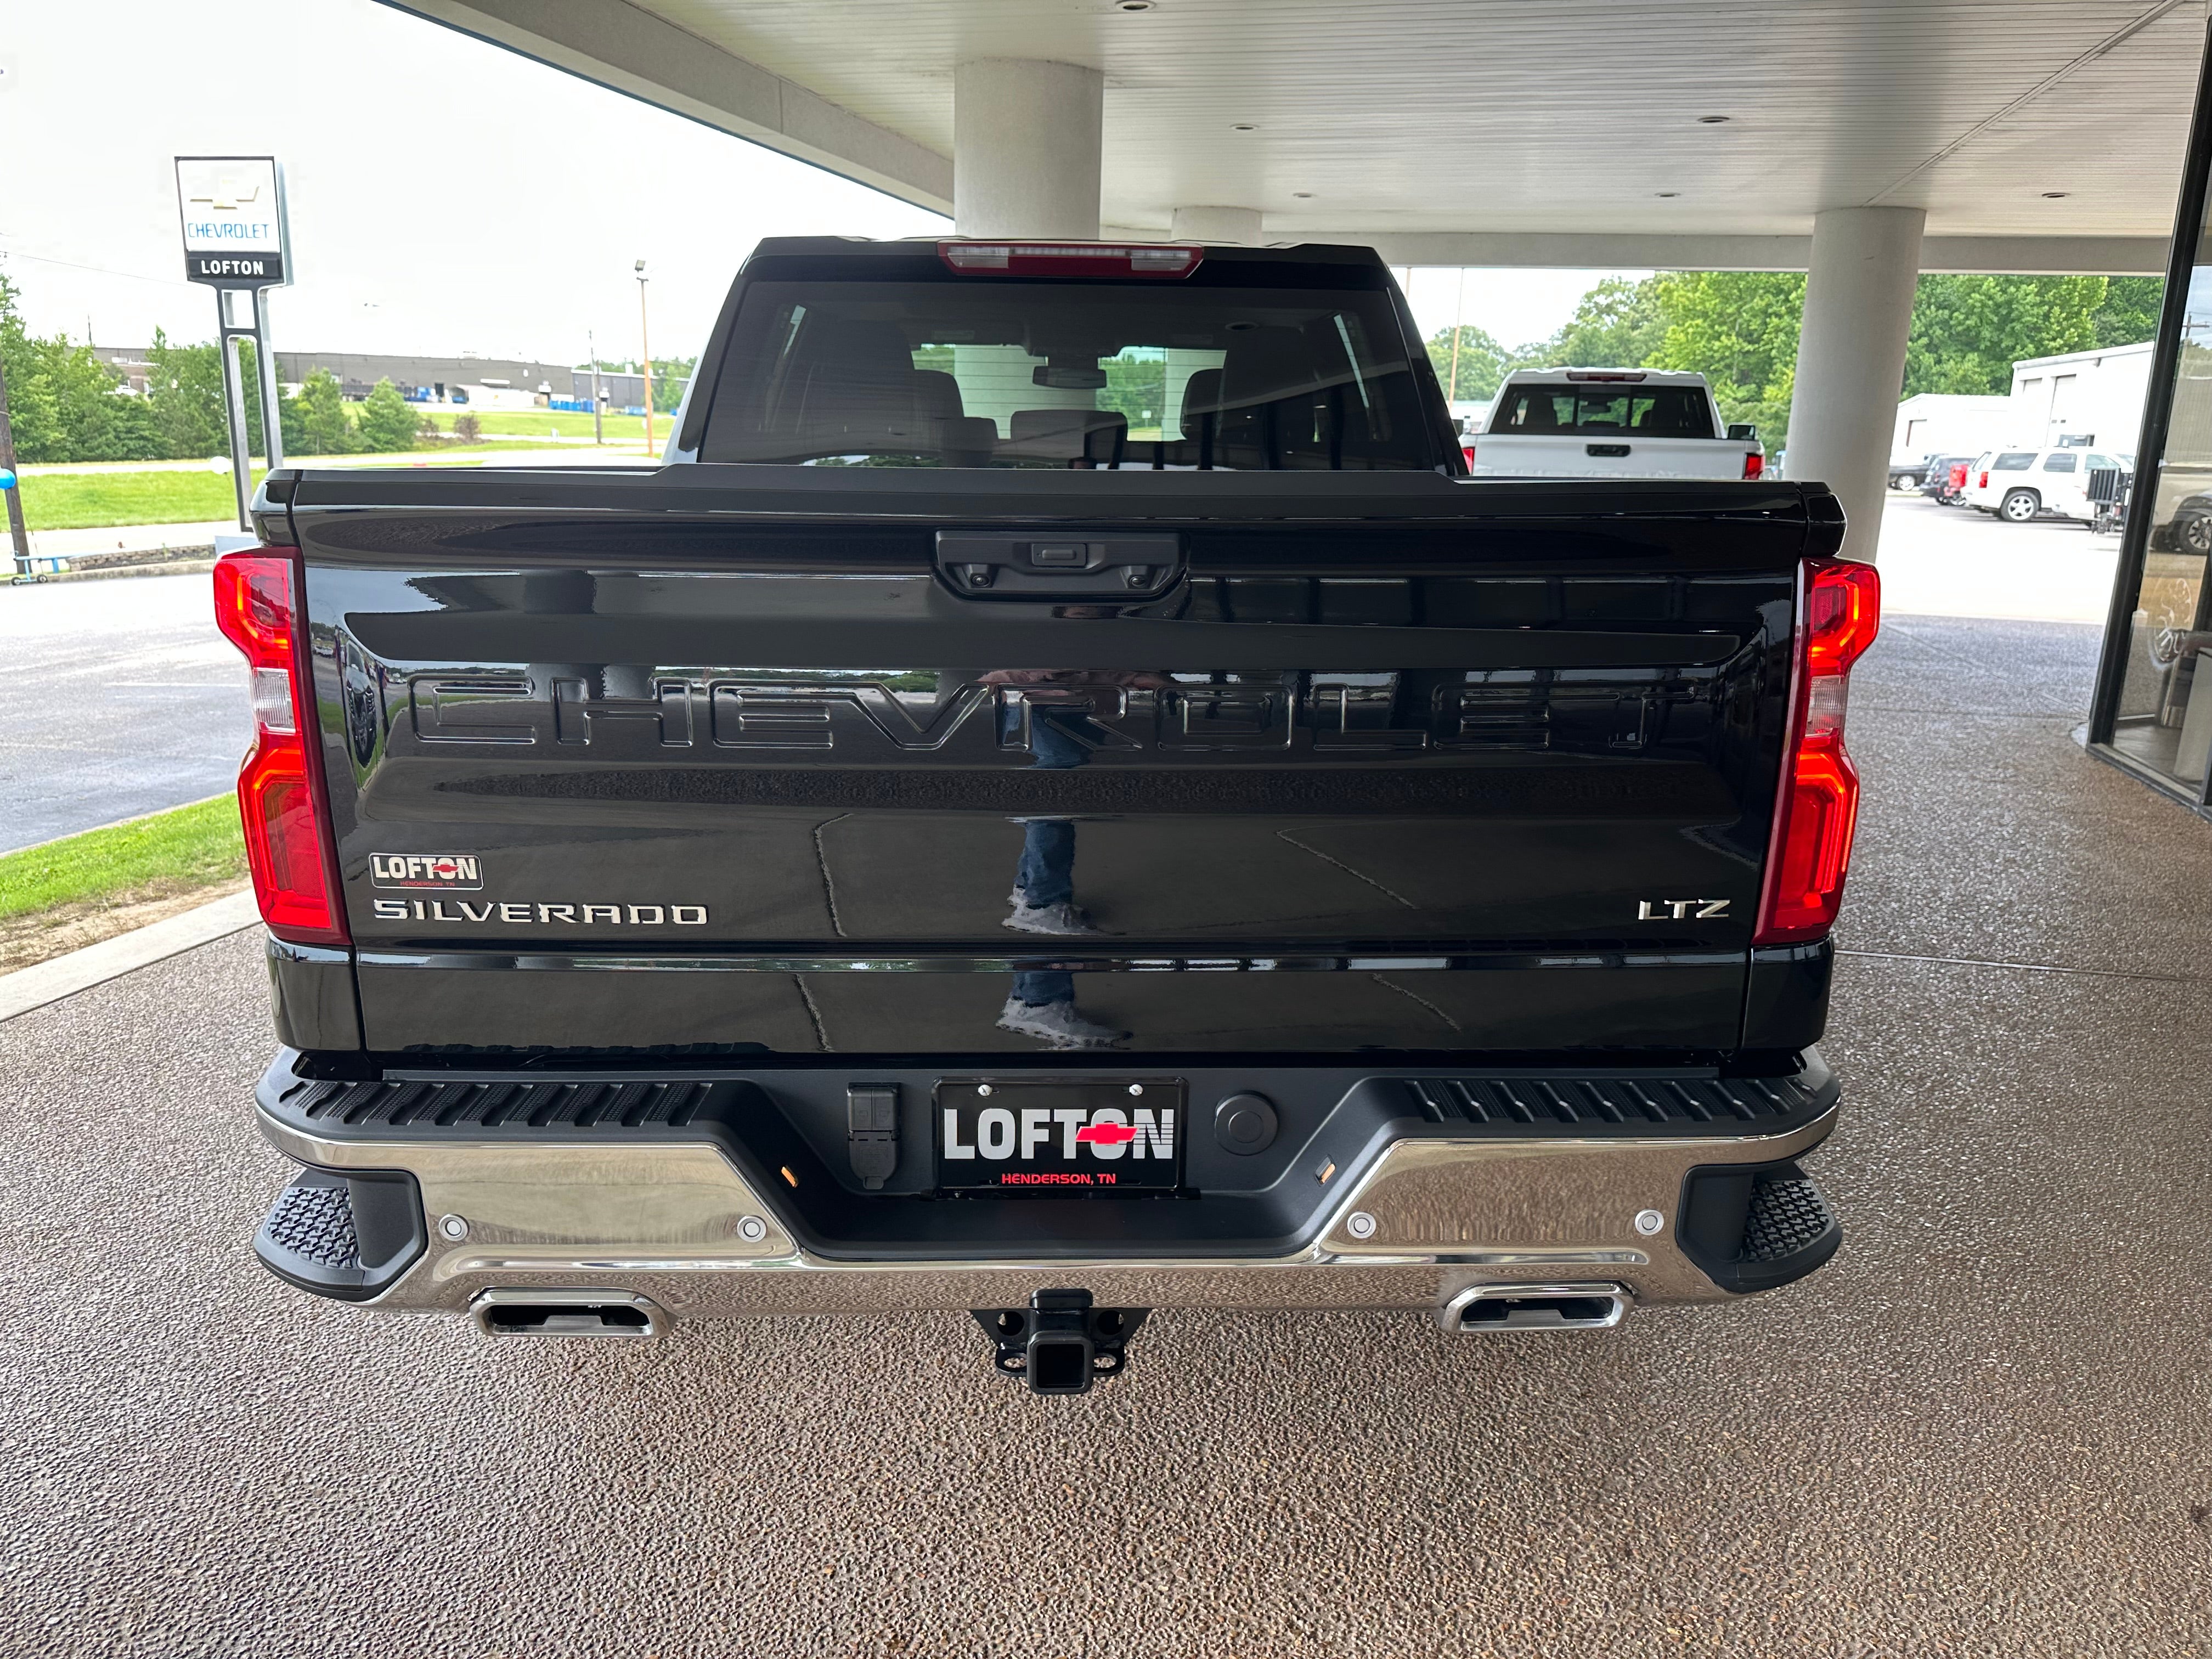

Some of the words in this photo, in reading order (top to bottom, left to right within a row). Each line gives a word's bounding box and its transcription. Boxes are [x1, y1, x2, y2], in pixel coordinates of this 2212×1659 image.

[188, 223, 269, 238] CHEVROLET
[201, 260, 264, 275] LOFTON
[407, 673, 1696, 749] CHEVROLET
[373, 856, 477, 879] LOFTON
[374, 899, 708, 924] SILVERADO
[1638, 899, 1730, 920] LTZ
[944, 1108, 1174, 1160] LOFTON
[1002, 1173, 1094, 1186] HENDERSON,
[1097, 1173, 1116, 1184] TN
